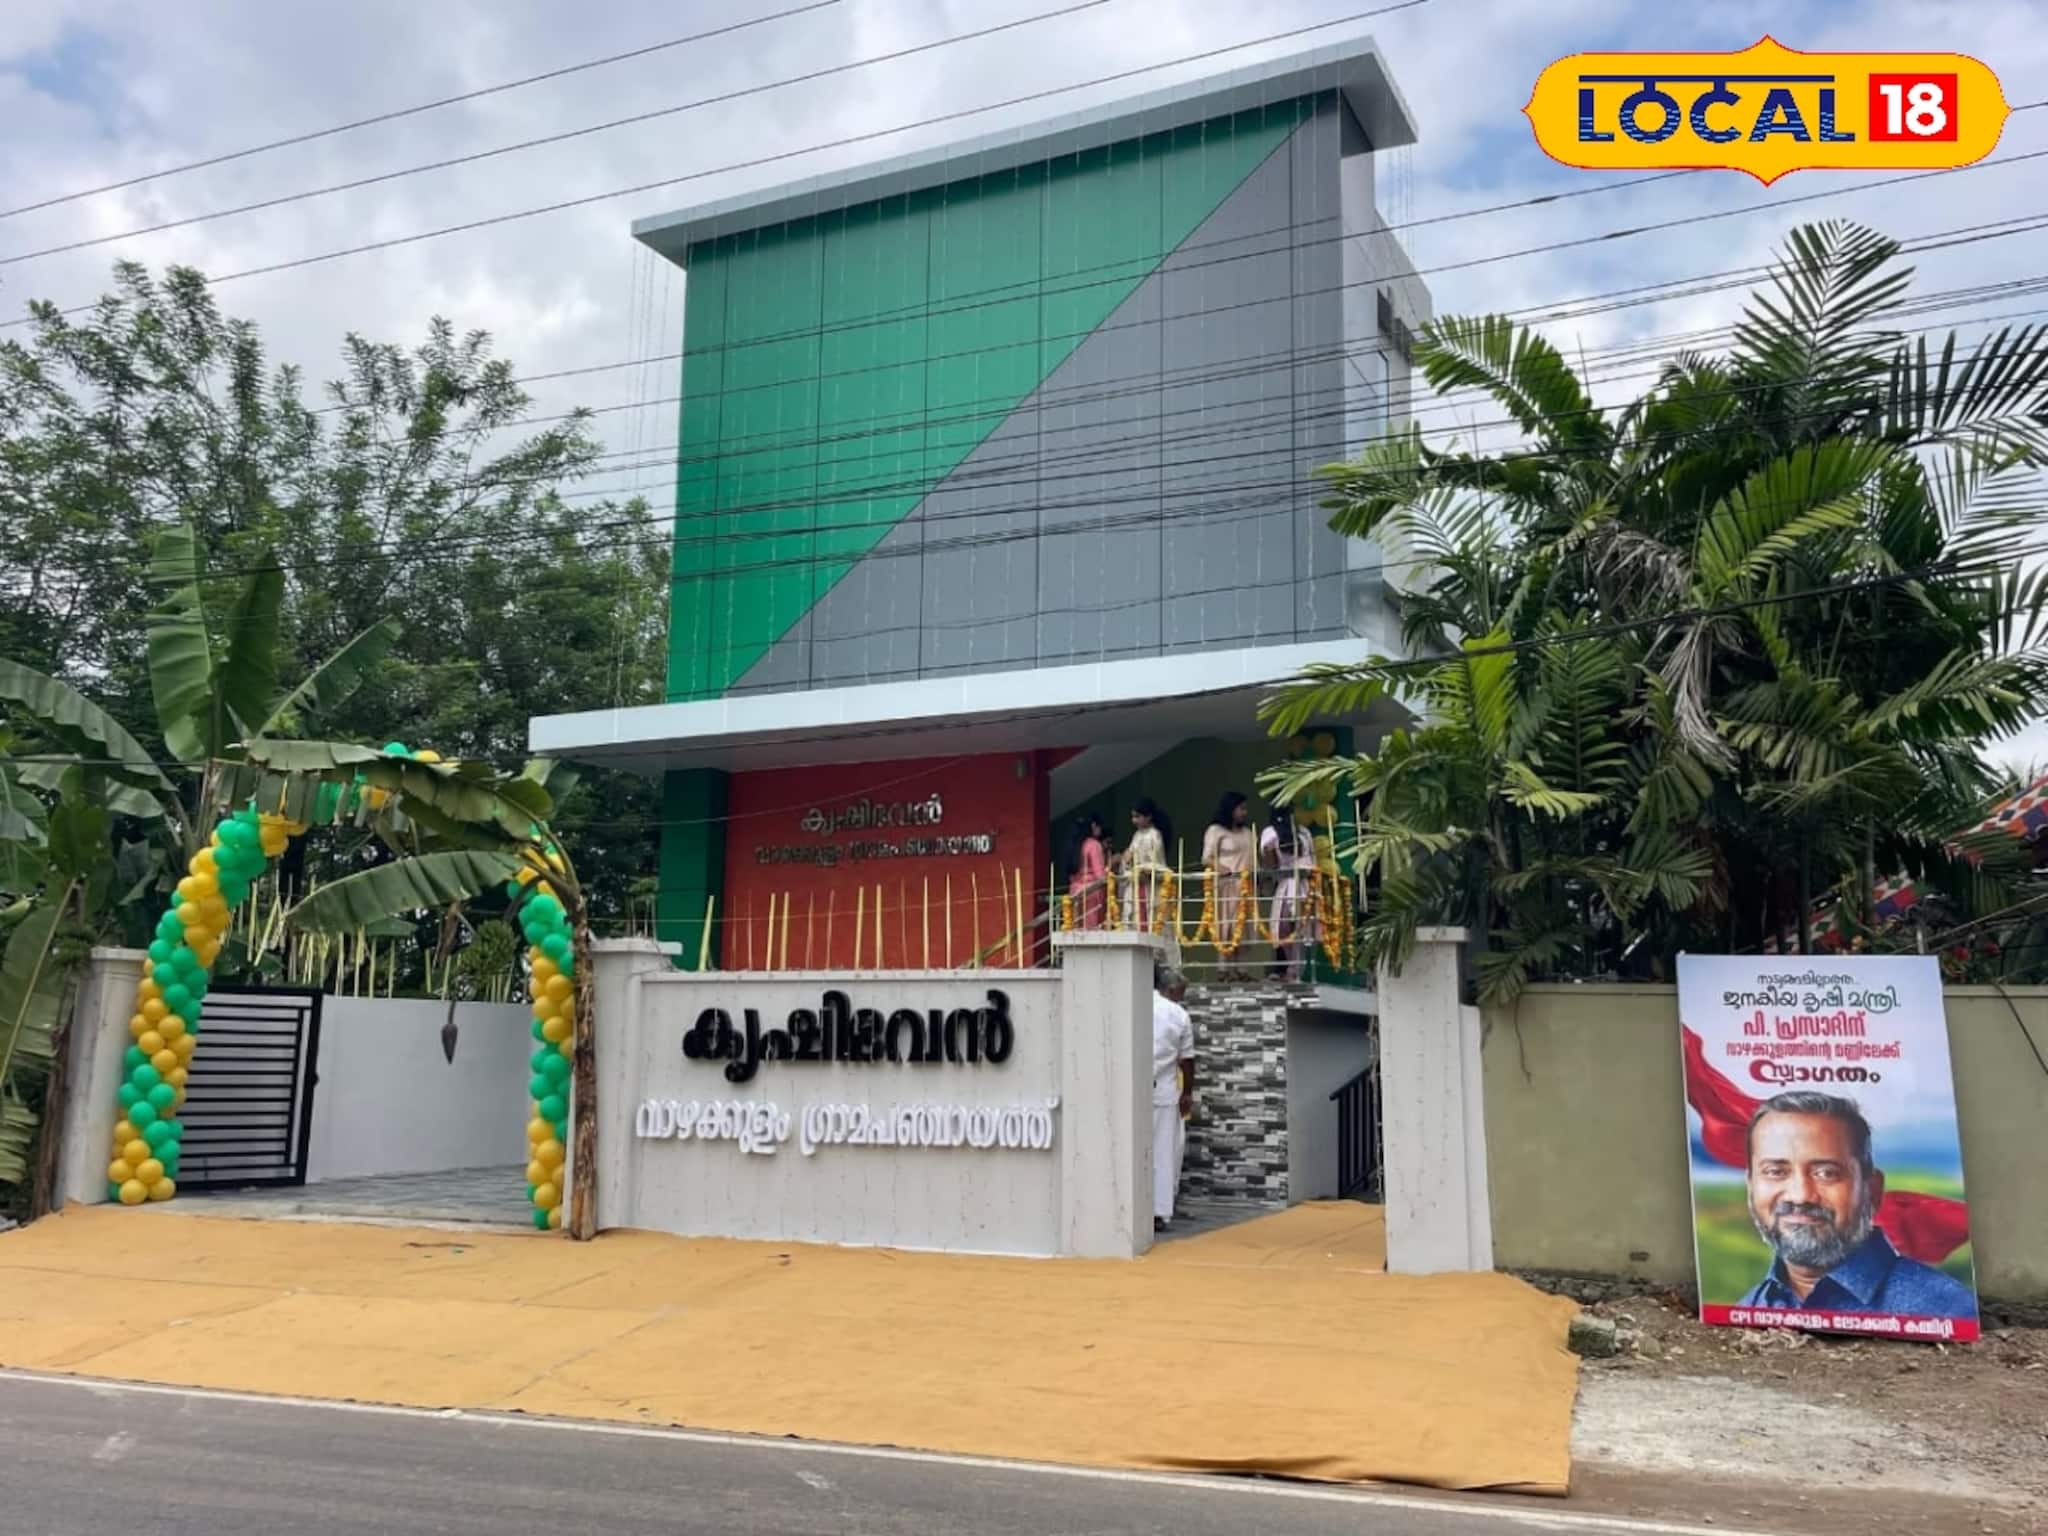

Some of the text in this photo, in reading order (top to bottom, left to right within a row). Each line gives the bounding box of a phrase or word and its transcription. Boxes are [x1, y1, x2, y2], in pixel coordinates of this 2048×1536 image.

[1723, 985, 1798, 1010] ജനകീയ
[1802, 985, 1843, 1013] കൃഷി
[682, 989, 1015, 1083] കൃഷിഭവൻ
[1744, 1010, 1866, 1039] പി. പ്രസാദിന്
[1749, 1059, 1881, 1086] സ്വാഗതം
[635, 1099, 791, 1155] വാഴക്കുളം
[1729, 1310, 1751, 1324] CPI
